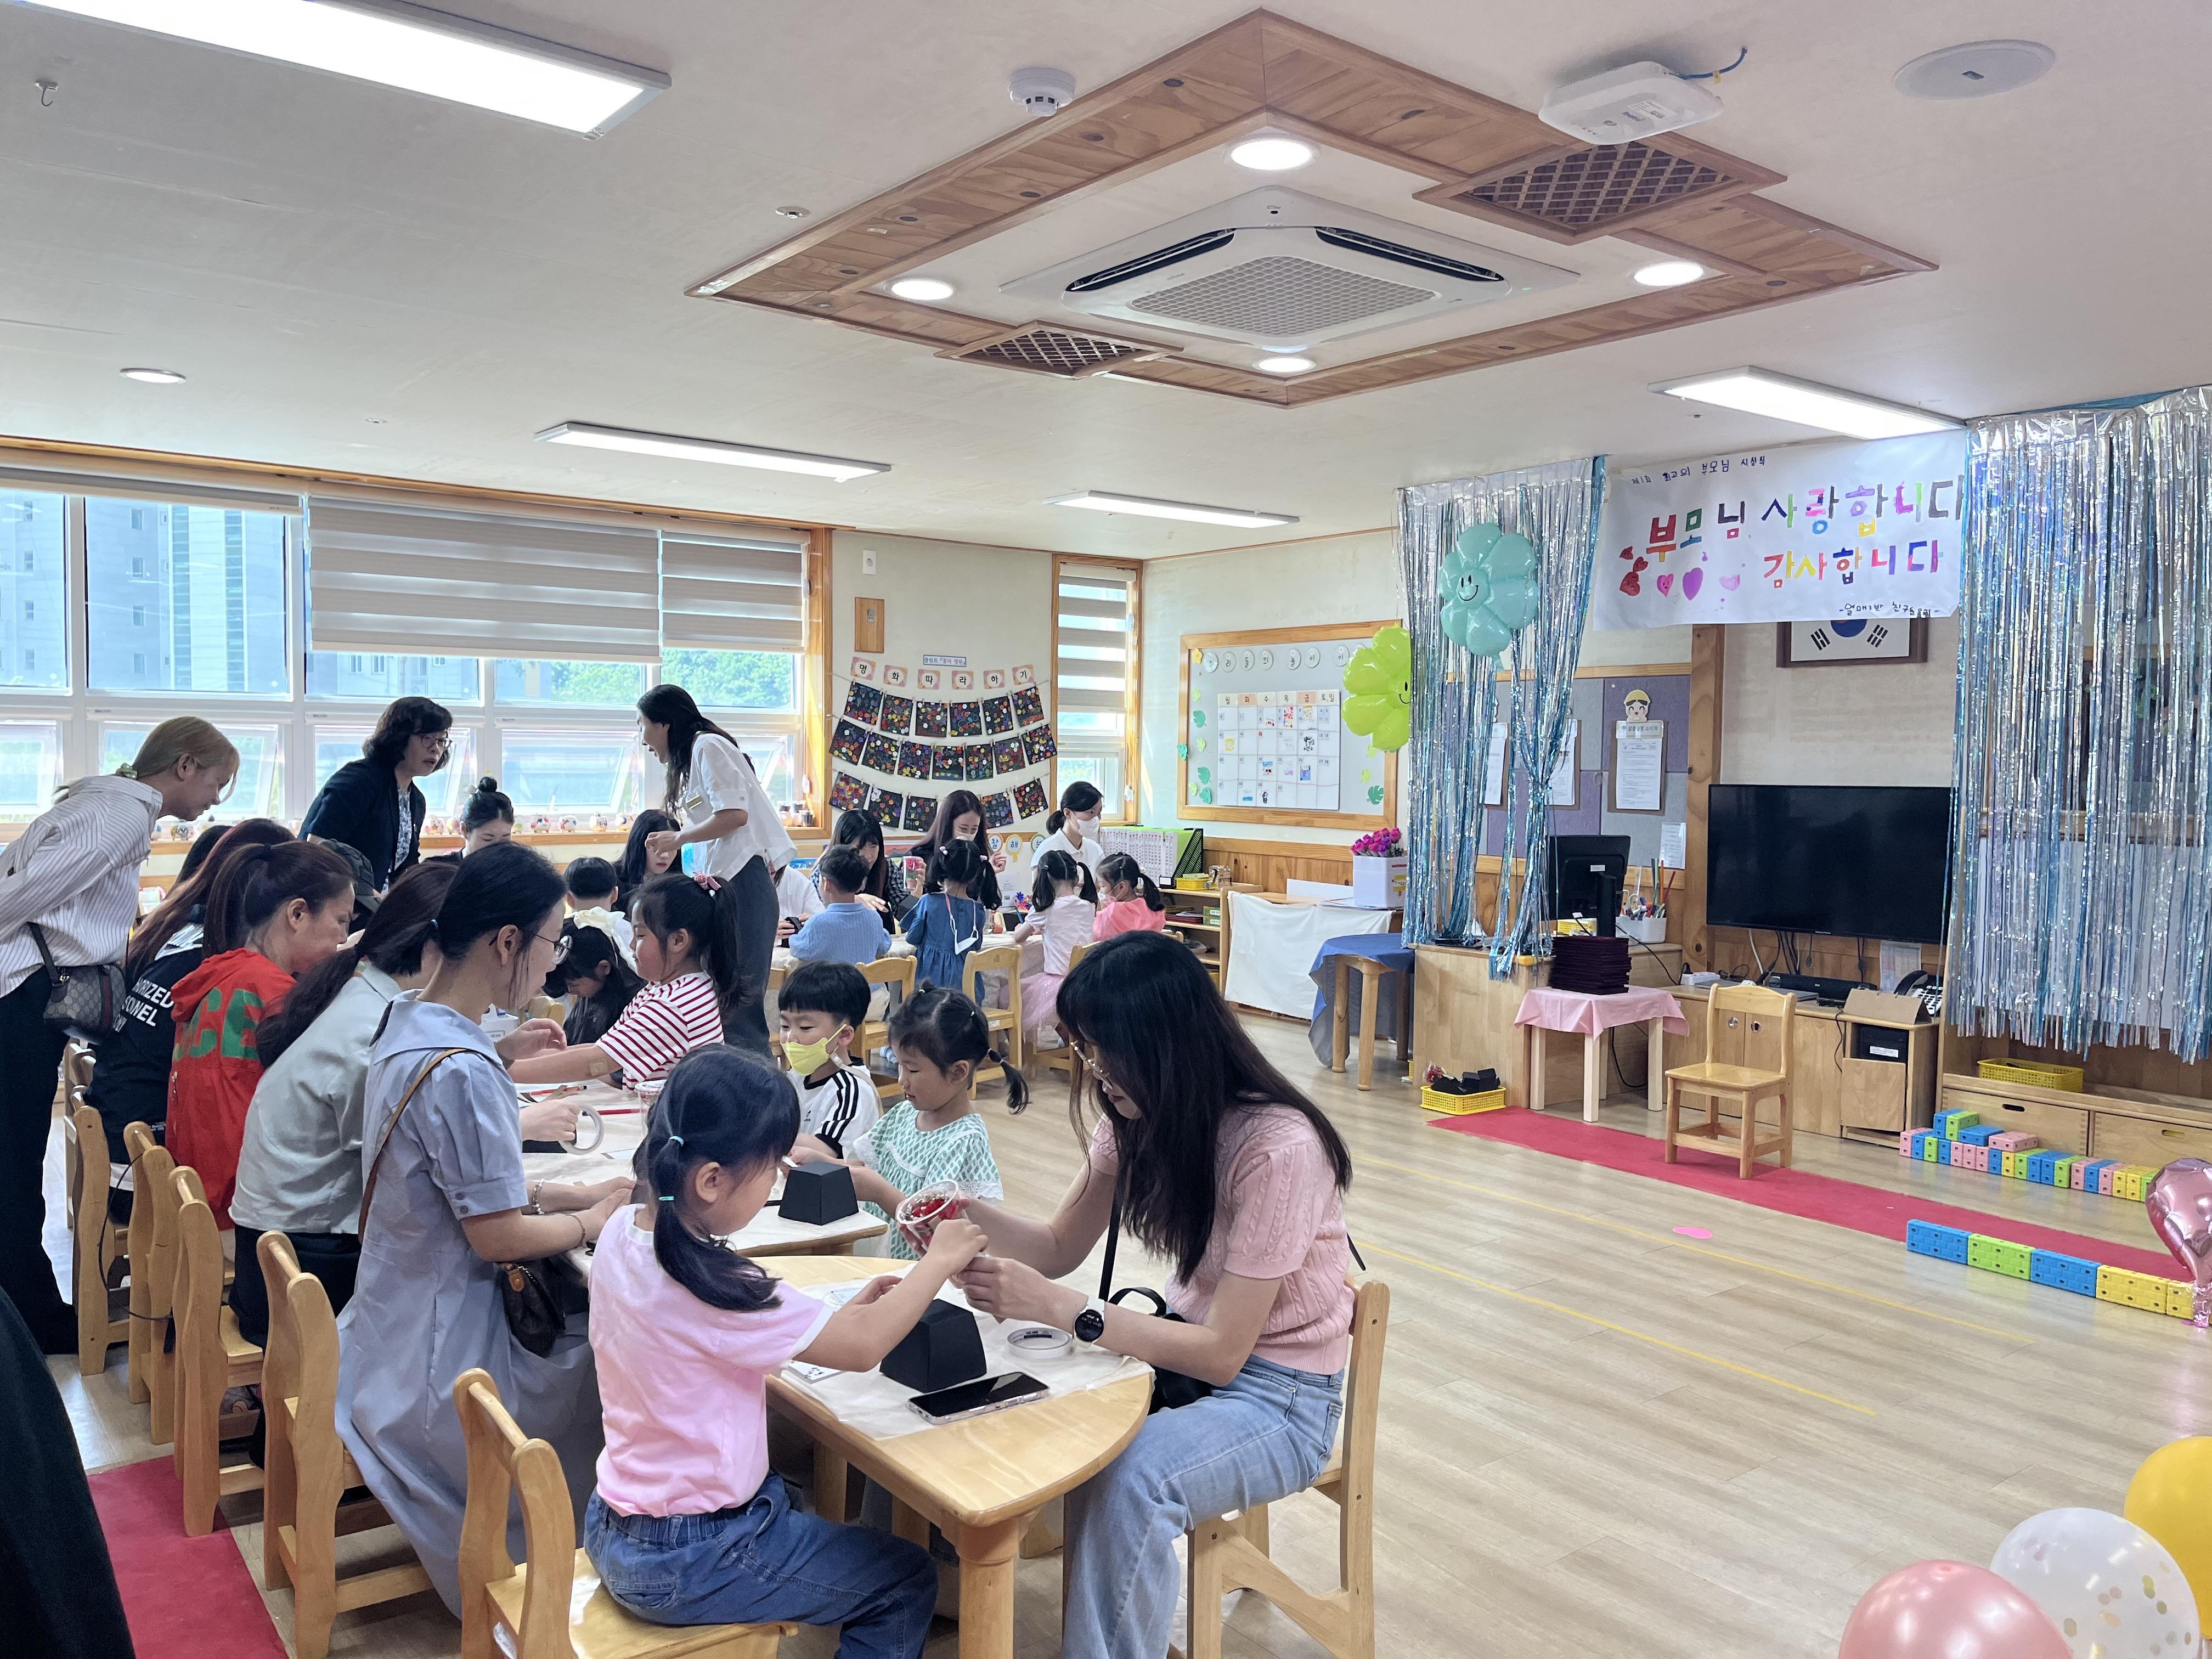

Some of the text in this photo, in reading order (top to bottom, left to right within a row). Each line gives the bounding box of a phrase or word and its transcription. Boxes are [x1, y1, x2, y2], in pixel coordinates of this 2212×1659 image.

[1662, 466, 1690, 482] 최고의
[1702, 459, 1729, 475] 부모님
[1741, 455, 1765, 466] 시상식
[1646, 474, 1964, 562] 부모님 사랑합니다
[1764, 539, 1943, 589] 감사합니다
[1011, 840, 1019, 848] 해
